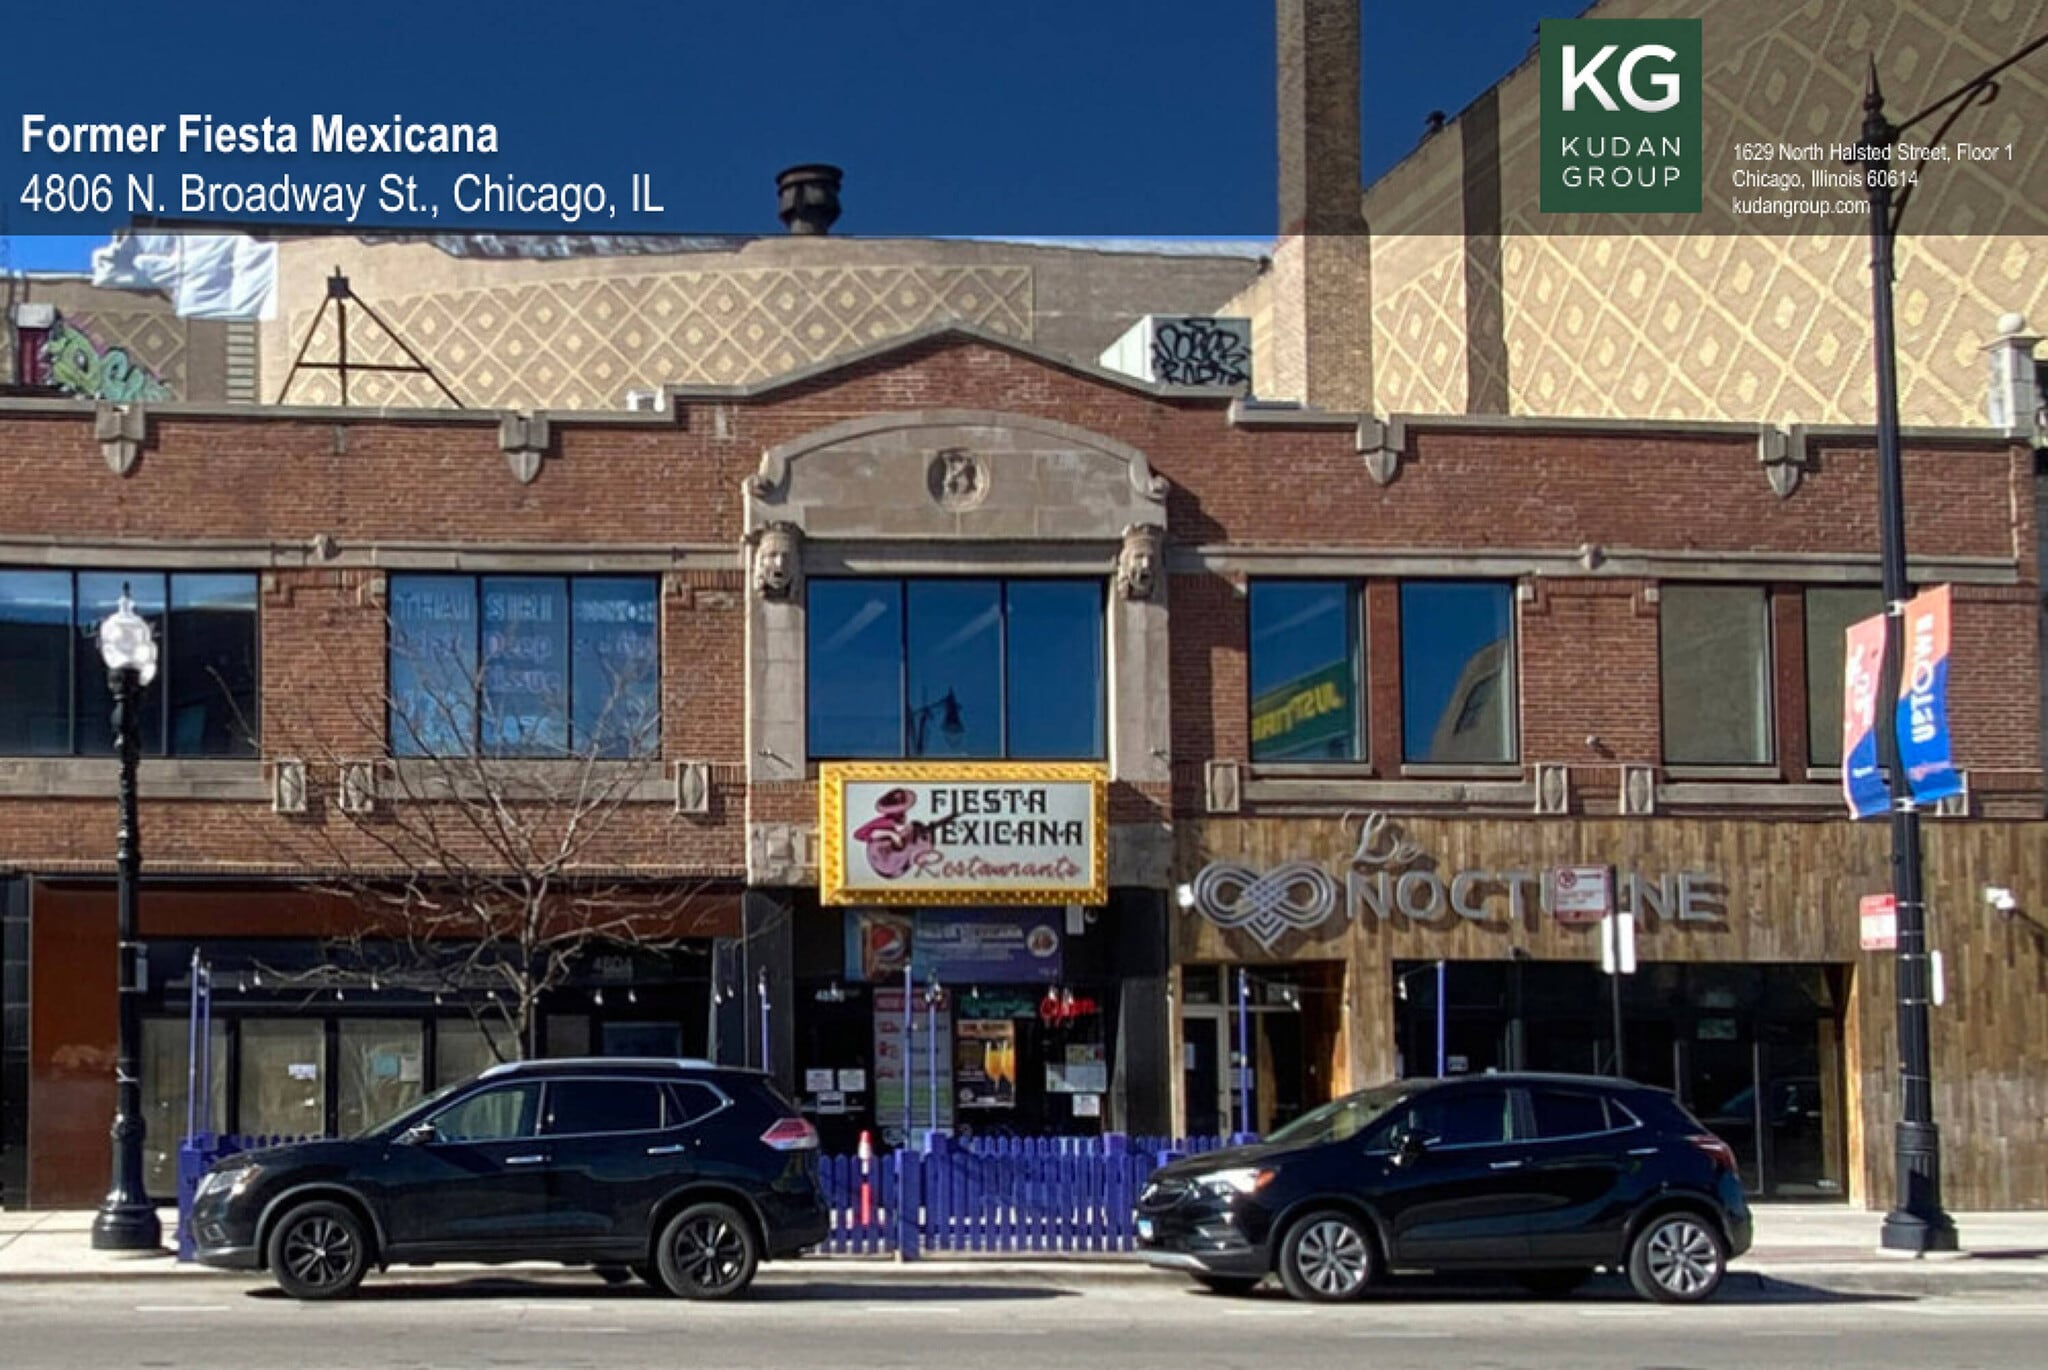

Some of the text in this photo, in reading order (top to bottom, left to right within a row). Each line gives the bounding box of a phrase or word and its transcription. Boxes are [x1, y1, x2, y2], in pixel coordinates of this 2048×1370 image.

[1910, 612, 1937, 744] UPTOWN
[930, 789, 1047, 815] FIESTA
[911, 820, 1083, 846] MEXICANA
[1341, 810, 1424, 865] Le
[1346, 871, 1717, 921] NOCTNE
